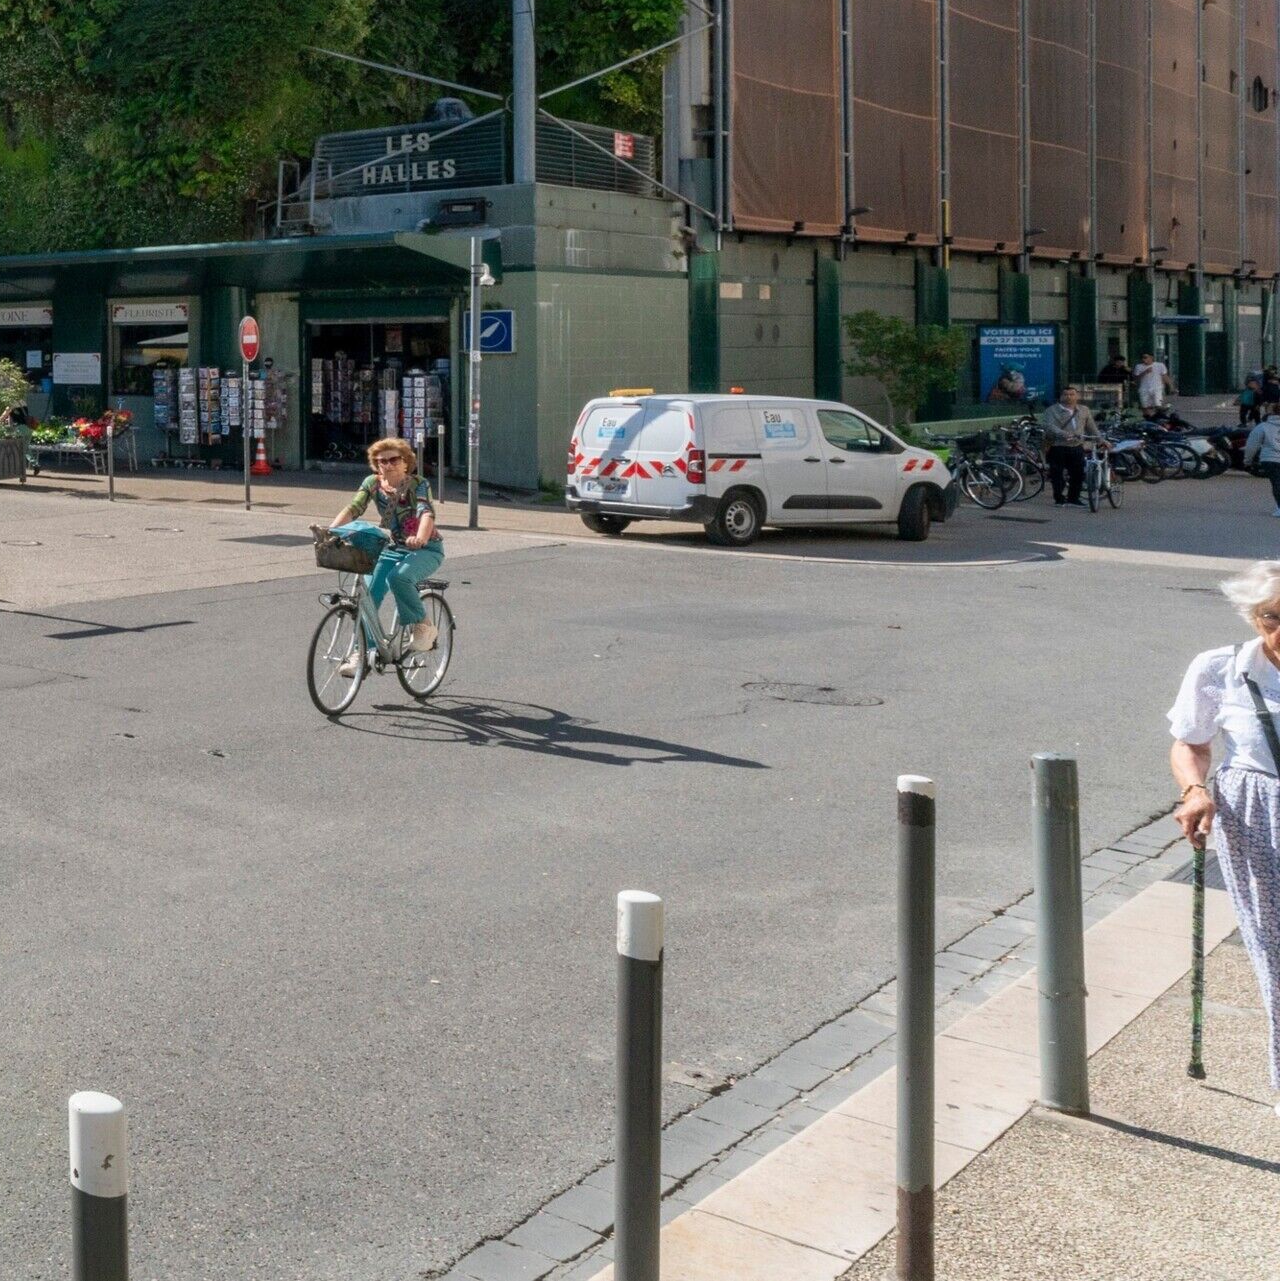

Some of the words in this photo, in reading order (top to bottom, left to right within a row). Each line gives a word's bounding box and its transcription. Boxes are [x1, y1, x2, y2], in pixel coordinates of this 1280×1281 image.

[386, 132, 430, 154] LES
[362, 159, 456, 184] HALLES
[124, 308, 175, 318] FLEURISTE
[602, 417, 617, 427] Eau
[763, 411, 781, 423] Eau
